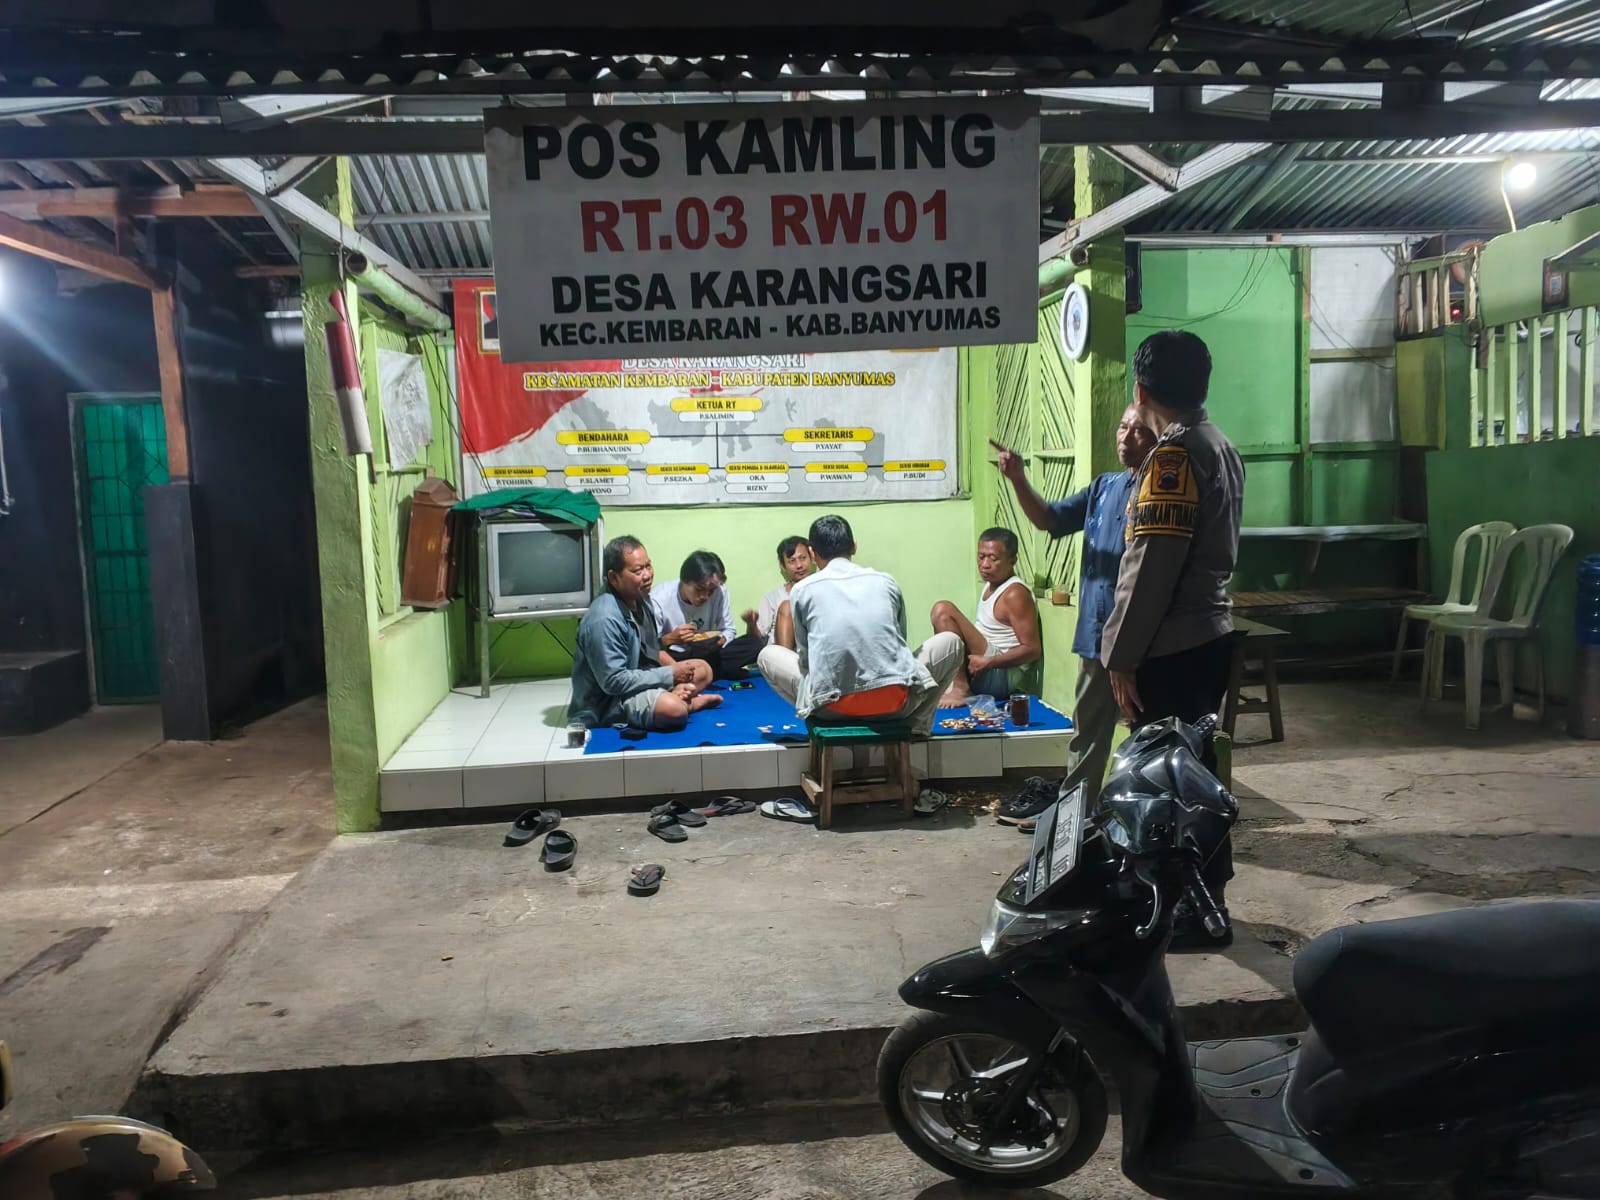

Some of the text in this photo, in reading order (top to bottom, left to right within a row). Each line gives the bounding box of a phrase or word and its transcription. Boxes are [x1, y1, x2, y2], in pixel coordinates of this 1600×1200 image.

[523, 112, 996, 181] POS KAMLING
[580, 189, 948, 252] RT.03 RW.01
[551, 261, 987, 314] DESA KARANGSARI
[539, 316, 761, 346] KEC.KEMBARAN
[786, 305, 1000, 337] KAB.BANYUMAS
[622, 353, 806, 370] DESA KARANGSARI
[525, 373, 622, 389] KECAMATAN
[624, 372, 710, 388] KEMBARAN
[721, 371, 810, 387] KABUPATEN
[812, 371, 896, 386] BANYUMAS
[696, 400, 736, 410] KETUA RT
[578, 433, 629, 442] BENDAHARA
[804, 430, 854, 439] SEKRETARIS
